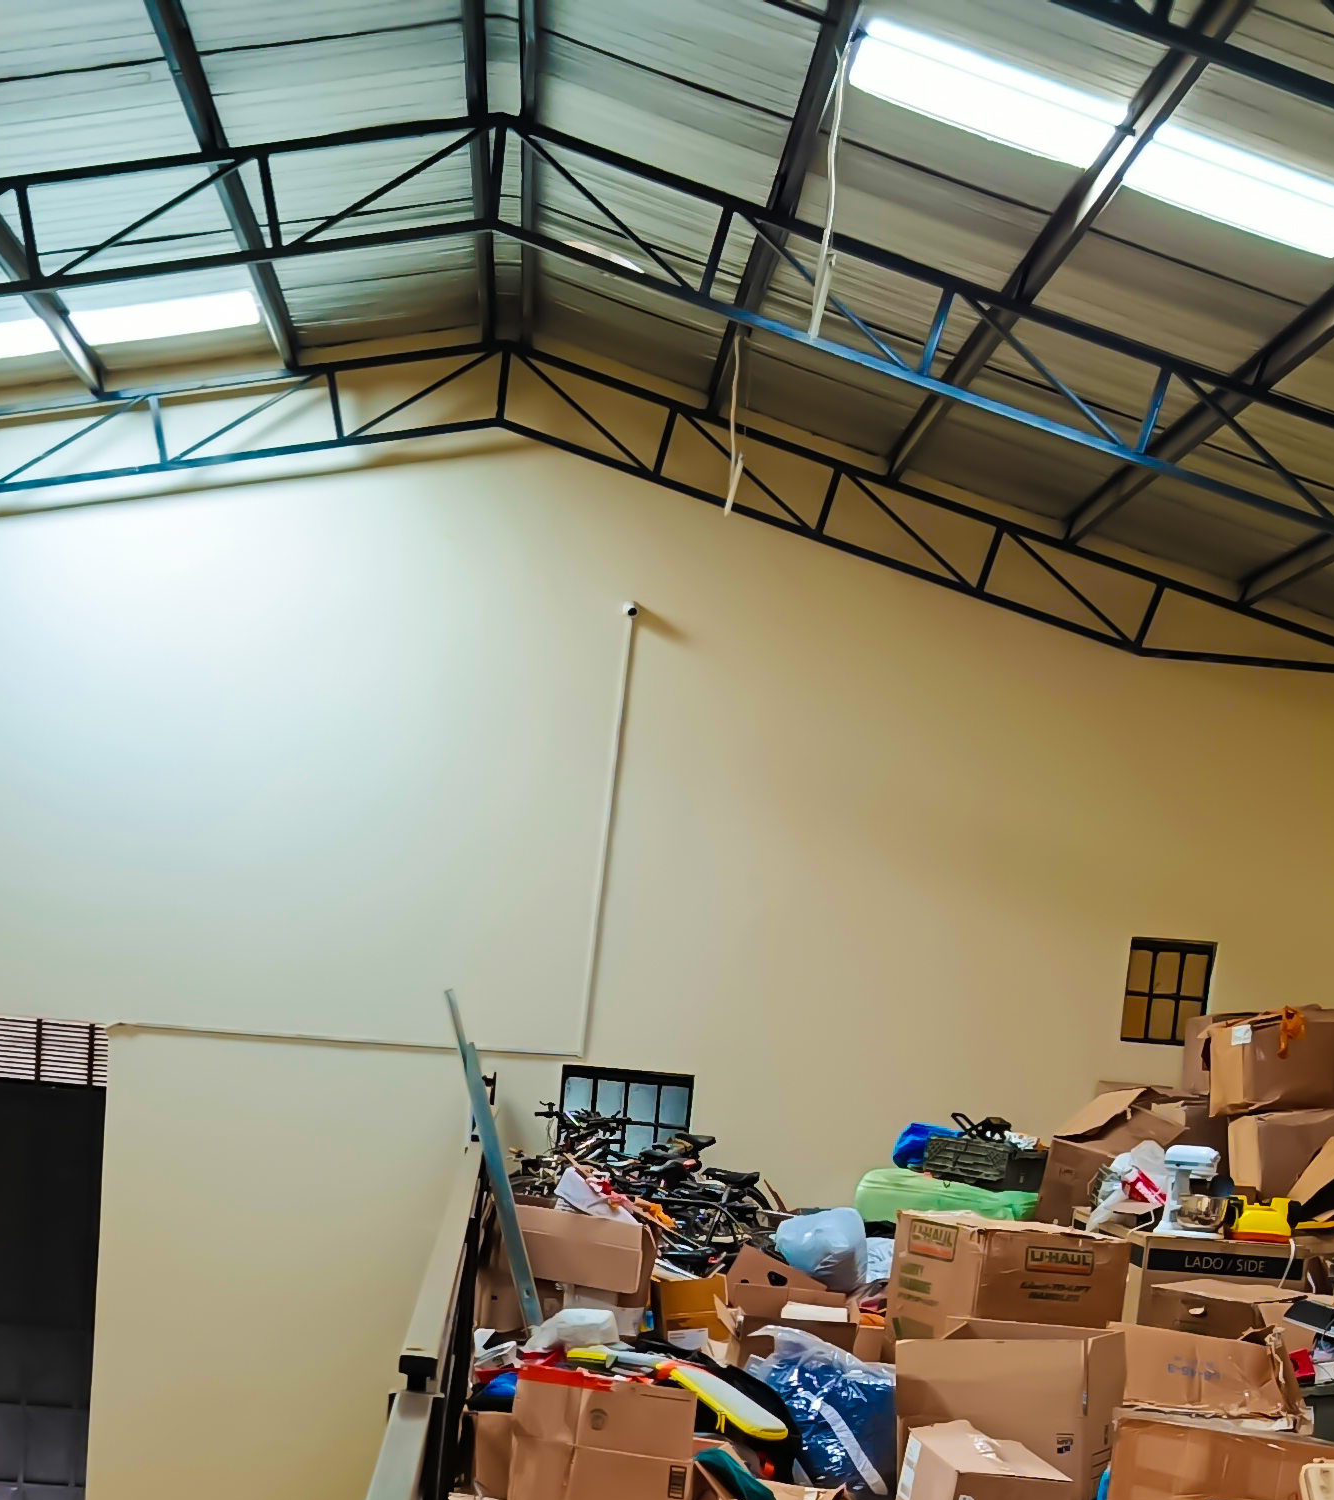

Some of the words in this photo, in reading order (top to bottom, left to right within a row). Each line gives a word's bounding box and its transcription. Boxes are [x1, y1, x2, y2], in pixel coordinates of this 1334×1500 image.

[1030, 1249, 1092, 1266] U-HAUL
[1184, 1255, 1224, 1270] LADO
[1235, 1259, 1266, 1273] SIDE
